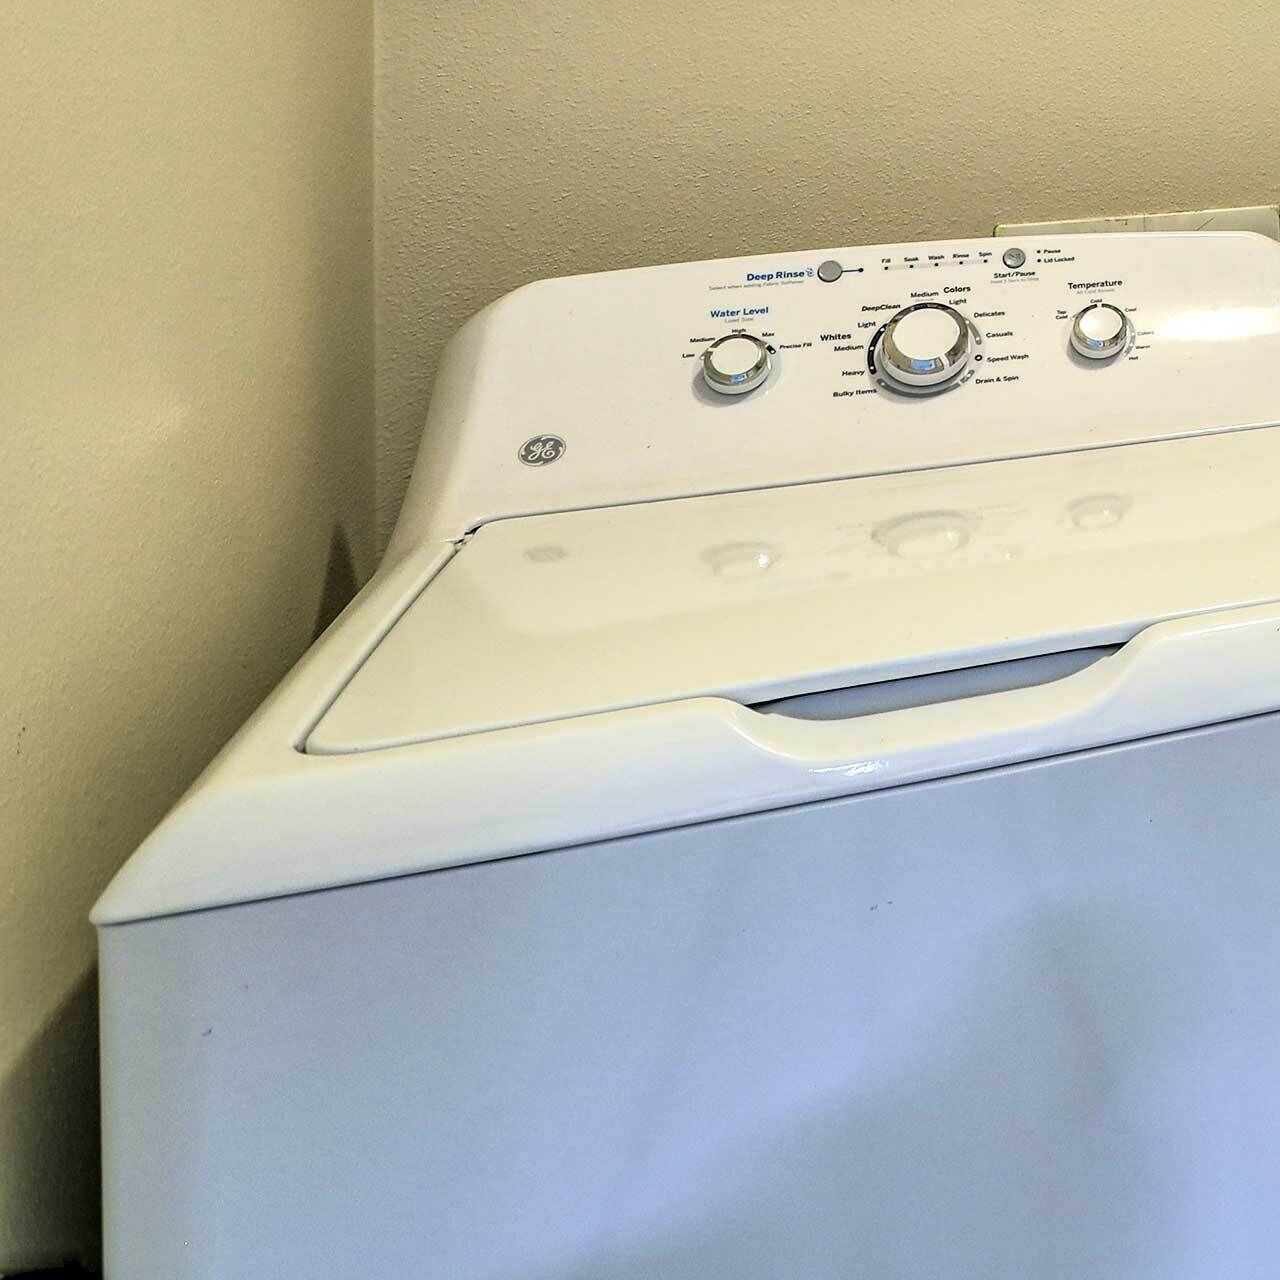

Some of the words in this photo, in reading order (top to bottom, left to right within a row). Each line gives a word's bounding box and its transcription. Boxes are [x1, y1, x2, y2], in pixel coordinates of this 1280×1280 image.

[746, 273, 774, 281] Deep
[775, 271, 805, 279] Rinse
[993, 271, 1036, 279] Start/Pause
[1067, 280, 1123, 290] Temperature
[943, 285, 971, 294] Colors
[910, 291, 939, 299] Medium
[948, 298, 967, 306] Light
[861, 303, 901, 312] DeepClean
[710, 309, 740, 318] Water
[743, 307, 769, 316] Level
[973, 310, 1006, 319] Delicates
[857, 321, 877, 329] Light
[820, 333, 852, 342] Whites
[985, 331, 1014, 339] Casuals
[986, 355, 1009, 363] Speed
[841, 369, 865, 377] Heavy
[975, 377, 995, 385] Drain
[832, 389, 854, 398] Bulky
[855, 388, 877, 396] Items
